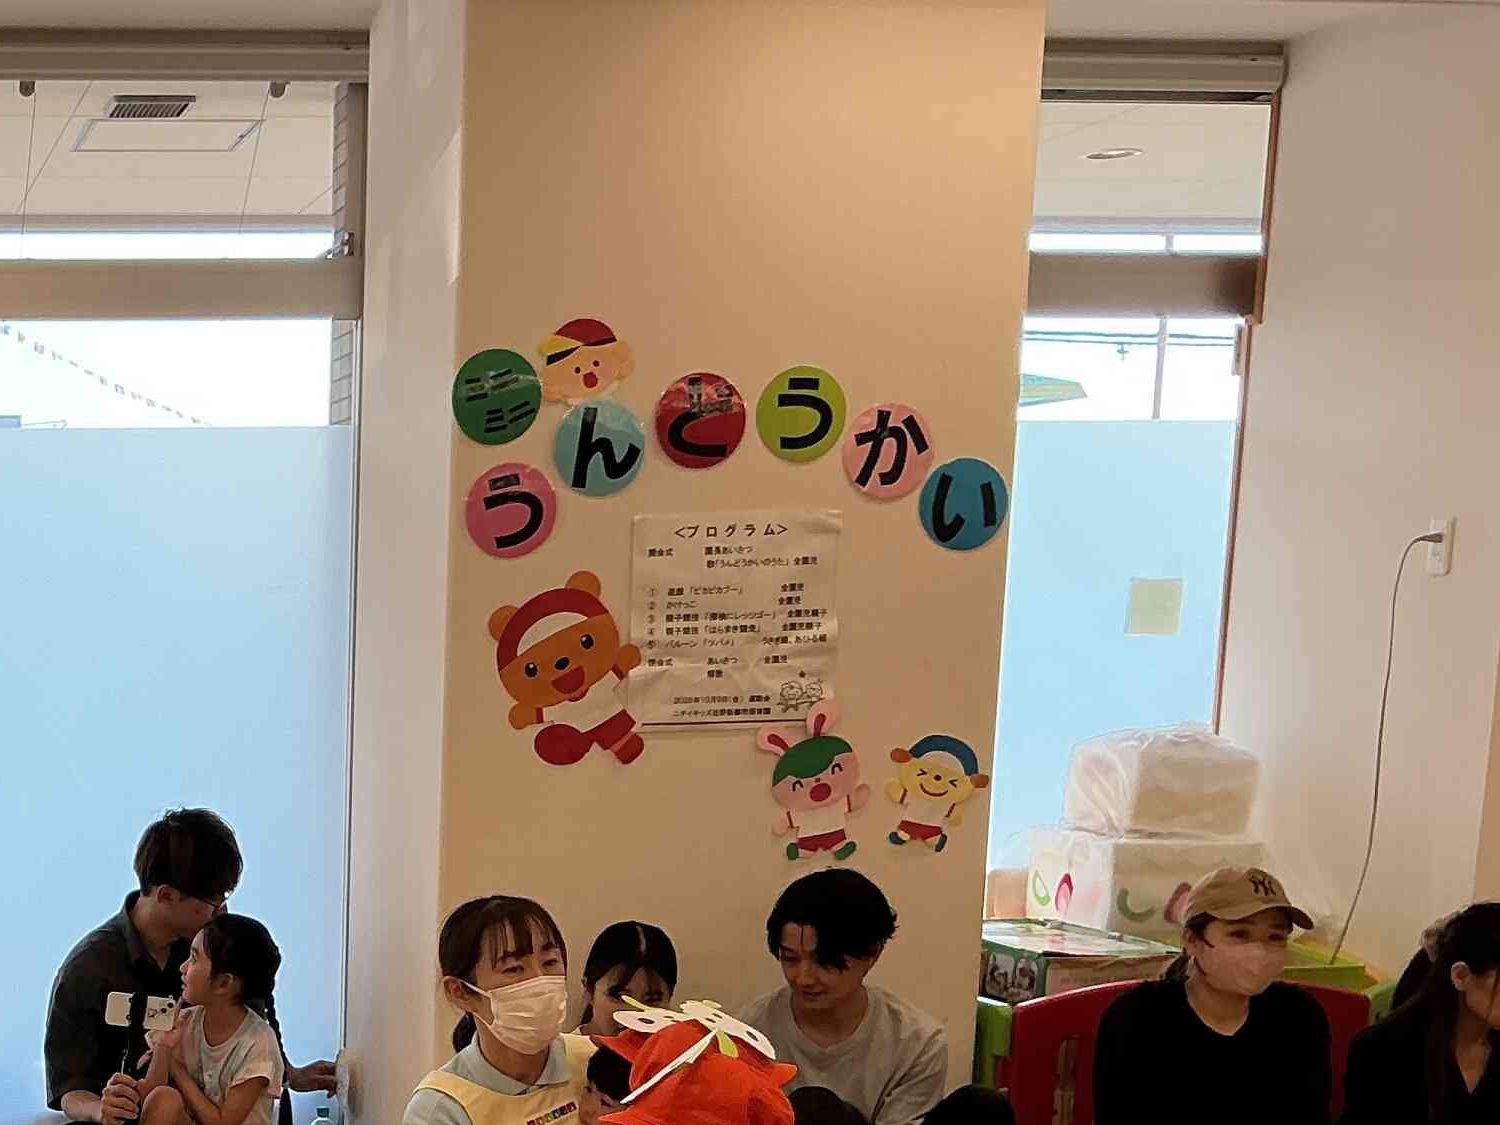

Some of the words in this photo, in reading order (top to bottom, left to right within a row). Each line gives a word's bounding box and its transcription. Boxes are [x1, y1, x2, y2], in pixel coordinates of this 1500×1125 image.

[484, 376, 998, 550] うんどうかい
